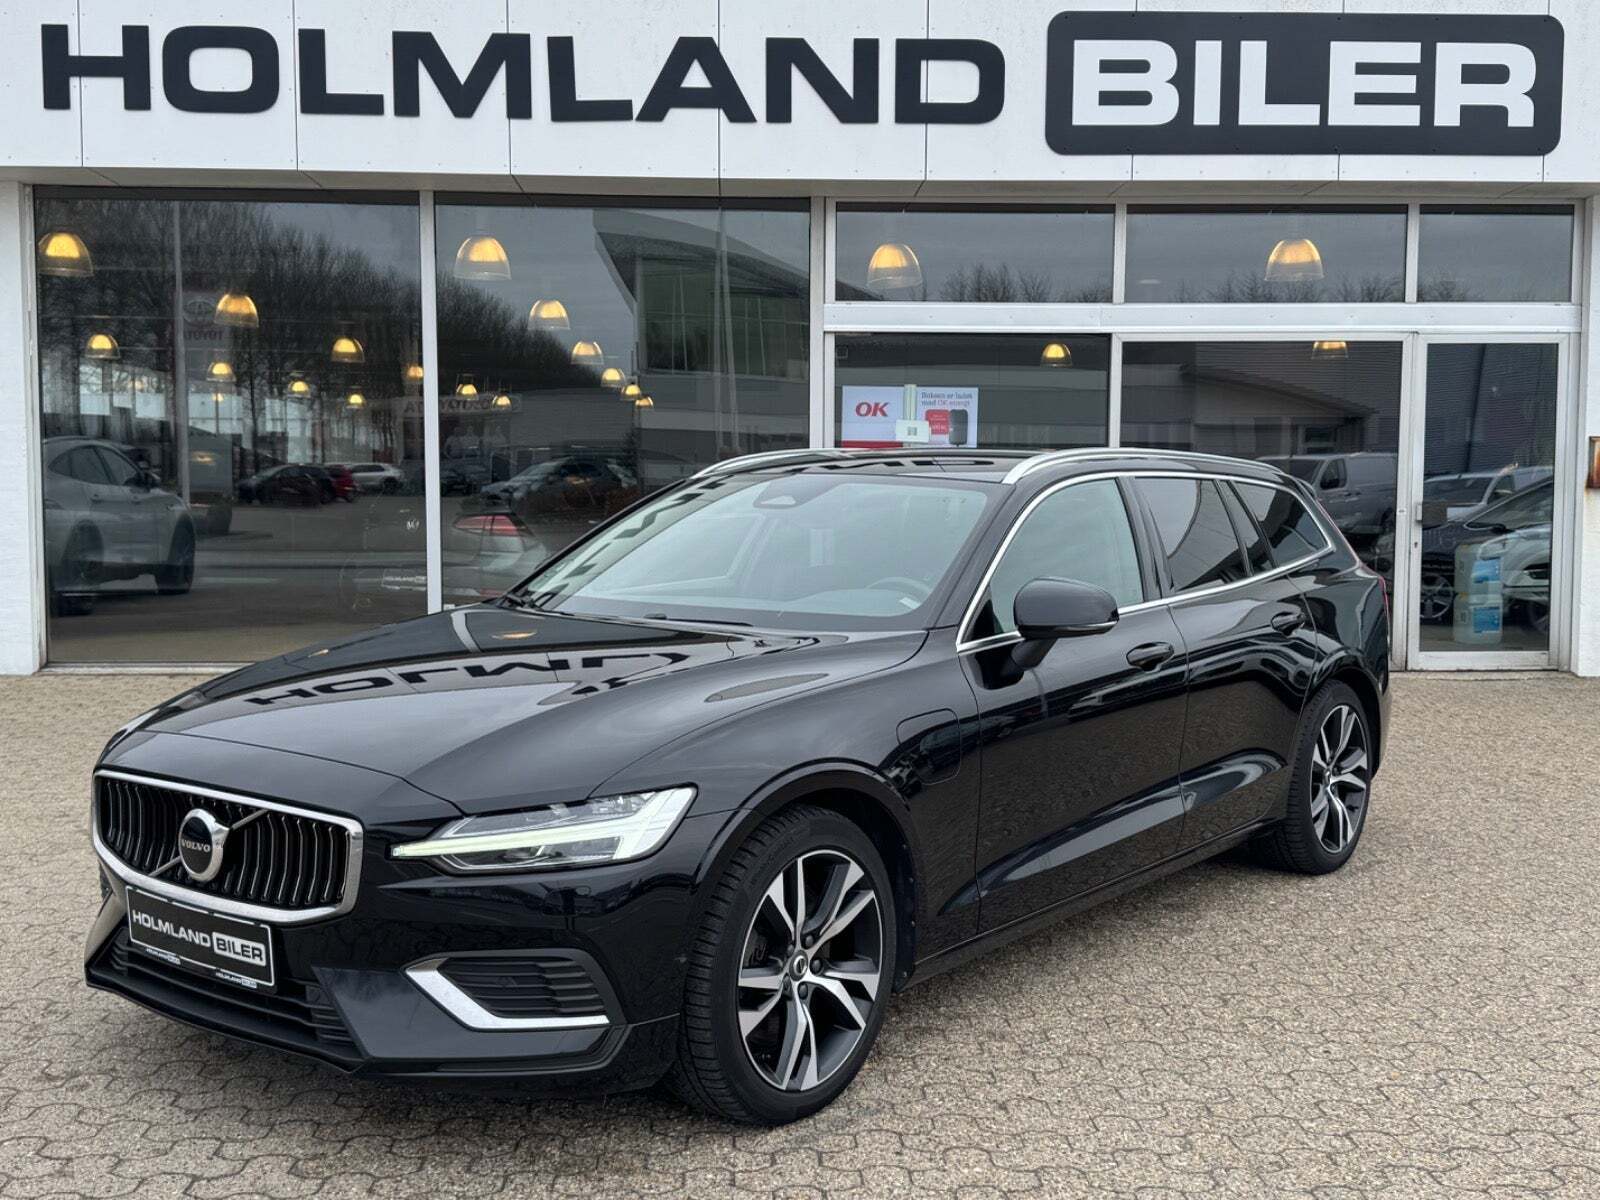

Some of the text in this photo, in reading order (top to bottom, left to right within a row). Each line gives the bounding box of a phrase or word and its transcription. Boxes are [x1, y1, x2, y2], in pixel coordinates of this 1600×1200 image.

[42, 25, 1537, 128] HOLMLAND BILER
[855, 401, 889, 417] OK
[181, 838, 211, 853] VOLVO
[132, 909, 212, 948] HOLMLAND
[215, 937, 264, 962] BILER
